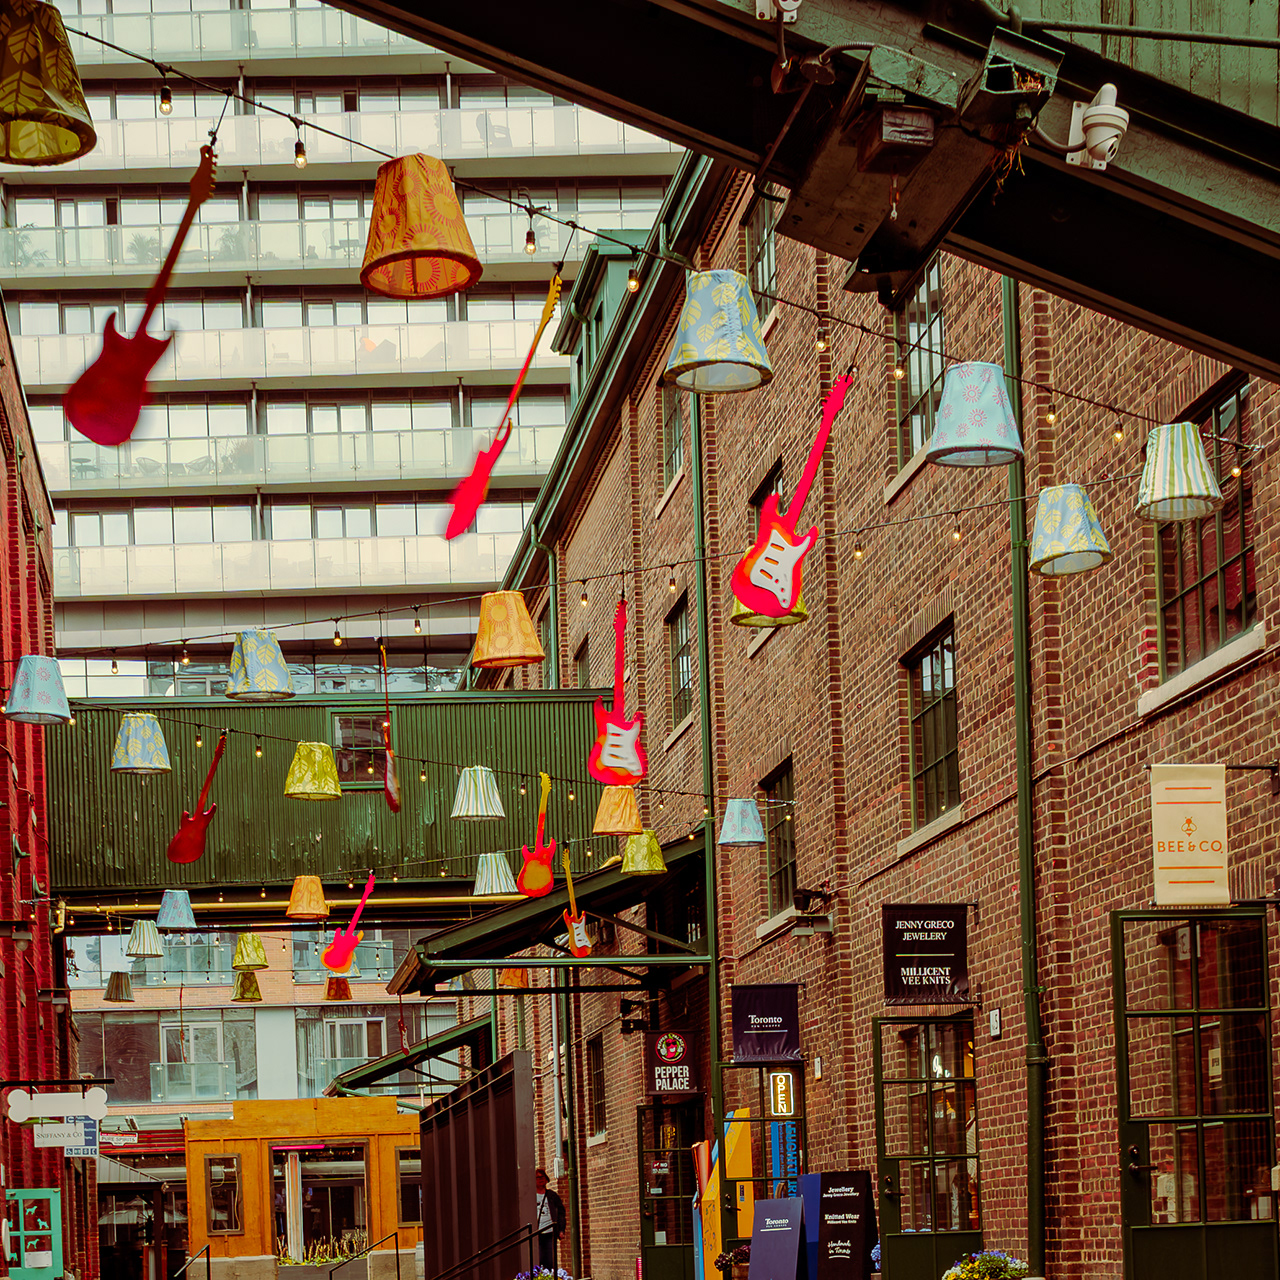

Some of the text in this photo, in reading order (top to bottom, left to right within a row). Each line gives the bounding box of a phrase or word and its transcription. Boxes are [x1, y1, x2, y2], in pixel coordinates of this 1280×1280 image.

[1157, 840, 1184, 853] BEE
[1188, 842, 1196, 852] &
[895, 920, 955, 929] JENNY GRECO
[902, 932, 948, 941] JEWELERY
[900, 967, 951, 976] MILLICENT
[901, 976, 951, 985] VEE KNITS
[748, 1014, 783, 1024] Toronto
[655, 1065, 689, 1078] PEPPER
[655, 1077, 690, 1090] PALACE
[776, 1075, 787, 1113] OPEN
[765, 1217, 789, 1225] Toronto
